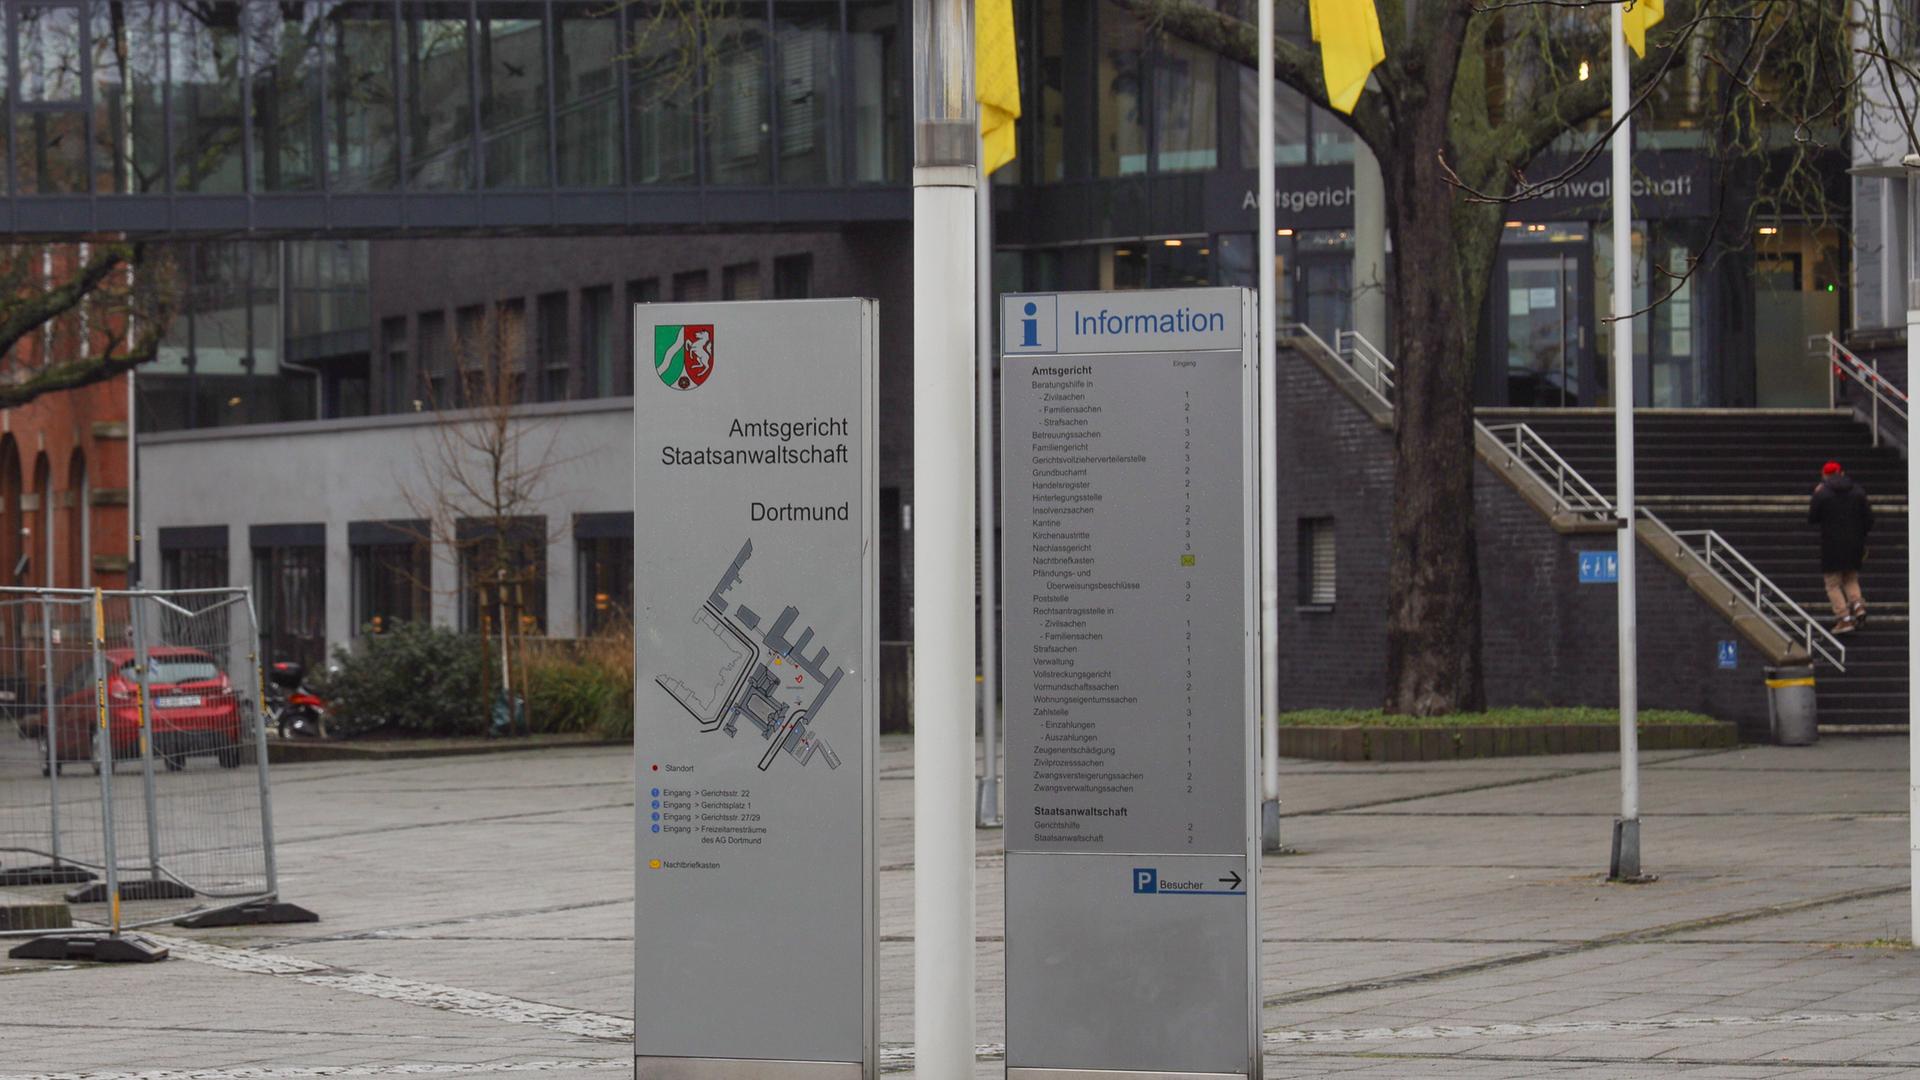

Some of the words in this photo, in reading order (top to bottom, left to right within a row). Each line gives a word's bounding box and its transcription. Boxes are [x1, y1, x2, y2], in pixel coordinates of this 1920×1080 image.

[1075, 308, 1224, 335] Information
[1032, 366, 1092, 377] Amtsgericht
[1032, 381, 1085, 390] Beratungshilfe
[1043, 393, 1085, 401] Zivilsachen
[1044, 405, 1101, 413] Familiensachen
[1185, 403, 1190, 411] 2
[1044, 418, 1088, 426] Strafsachen
[1185, 416, 1189, 424] 1
[729, 417, 848, 442] Amtsgericht
[1032, 431, 1101, 441] Betreuungssachen
[1032, 443, 1088, 453] Familiengericht
[661, 444, 848, 466] Staatsanwaltschaft
[1032, 455, 1146, 465] Gerichtsvollzieherverteilerstelle
[1032, 468, 1087, 477] Grundbuchamt
[1032, 481, 1090, 491] Handelsregister
[1032, 494, 1102, 503] Hinterlegungsstelle
[751, 502, 849, 521] Dortmund
[1032, 519, 1060, 527] Kantine
[1032, 531, 1090, 540] Kirchenaustritte
[1185, 530, 1190, 538] 3
[1032, 544, 1092, 554] Nachlassgericht
[1185, 543, 1190, 551] 3
[1032, 557, 1094, 565] Nachtbriefkasten
[1032, 569, 1075, 579] Pfändungs-
[1047, 581, 1140, 591] Überweisungsbeschlüsse
[1185, 581, 1191, 589] 3
[1033, 594, 1069, 602] Poststelle
[1185, 594, 1191, 602] 2
[1033, 607, 1105, 617] Rechtsantragsstelle
[1107, 607, 1114, 615] in
[1045, 620, 1086, 628] Zivilsachen
[1045, 632, 1103, 640] Familiensachen
[1186, 632, 1191, 640] 2
[1033, 645, 1077, 653] Strafsachen
[1033, 658, 1074, 667] Verwaltung
[1033, 670, 1112, 680] Vollstreckungsgericht
[1186, 670, 1192, 678] 3
[1033, 683, 1119, 691] Vormundschaftssachen
[1186, 683, 1192, 691] 2
[1033, 695, 1138, 705] Wohnungseigentumssachen
[1187, 696, 1191, 704] 1
[1033, 708, 1069, 716] Zahlstelle
[1045, 721, 1096, 730] Einzahlungen
[1045, 733, 1097, 743] Auszahlungen
[1187, 734, 1191, 742] 1
[1033, 746, 1115, 755] Zeugenentschädigung
[665, 764, 694, 772] Standort
[1033, 759, 1104, 768] Zivilprozesssachen
[1033, 772, 1143, 781] Zwangsversteigerungssachen
[1187, 772, 1192, 780] 2
[663, 789, 691, 798] Eingang
[1033, 784, 1134, 794] Zwangsverwaltungssachen
[1187, 785, 1192, 793] 2
[663, 801, 691, 810] Eingang
[701, 801, 745, 809] Gerichtsplatz
[1034, 806, 1128, 817] Staatsanwaltschaft
[663, 814, 691, 822] Eingang
[663, 825, 691, 834] Eingang
[701, 825, 767, 833] Freizeitarresträume
[1034, 821, 1080, 830] Gerichtshilfe
[1188, 823, 1193, 831] 2
[1034, 834, 1104, 842] Staatsanwaltschaft
[1188, 836, 1193, 844] 2
[663, 861, 720, 869] Nachtbriefkasten
[1138, 872, 1151, 890] P
[1160, 879, 1204, 890] Besucher
